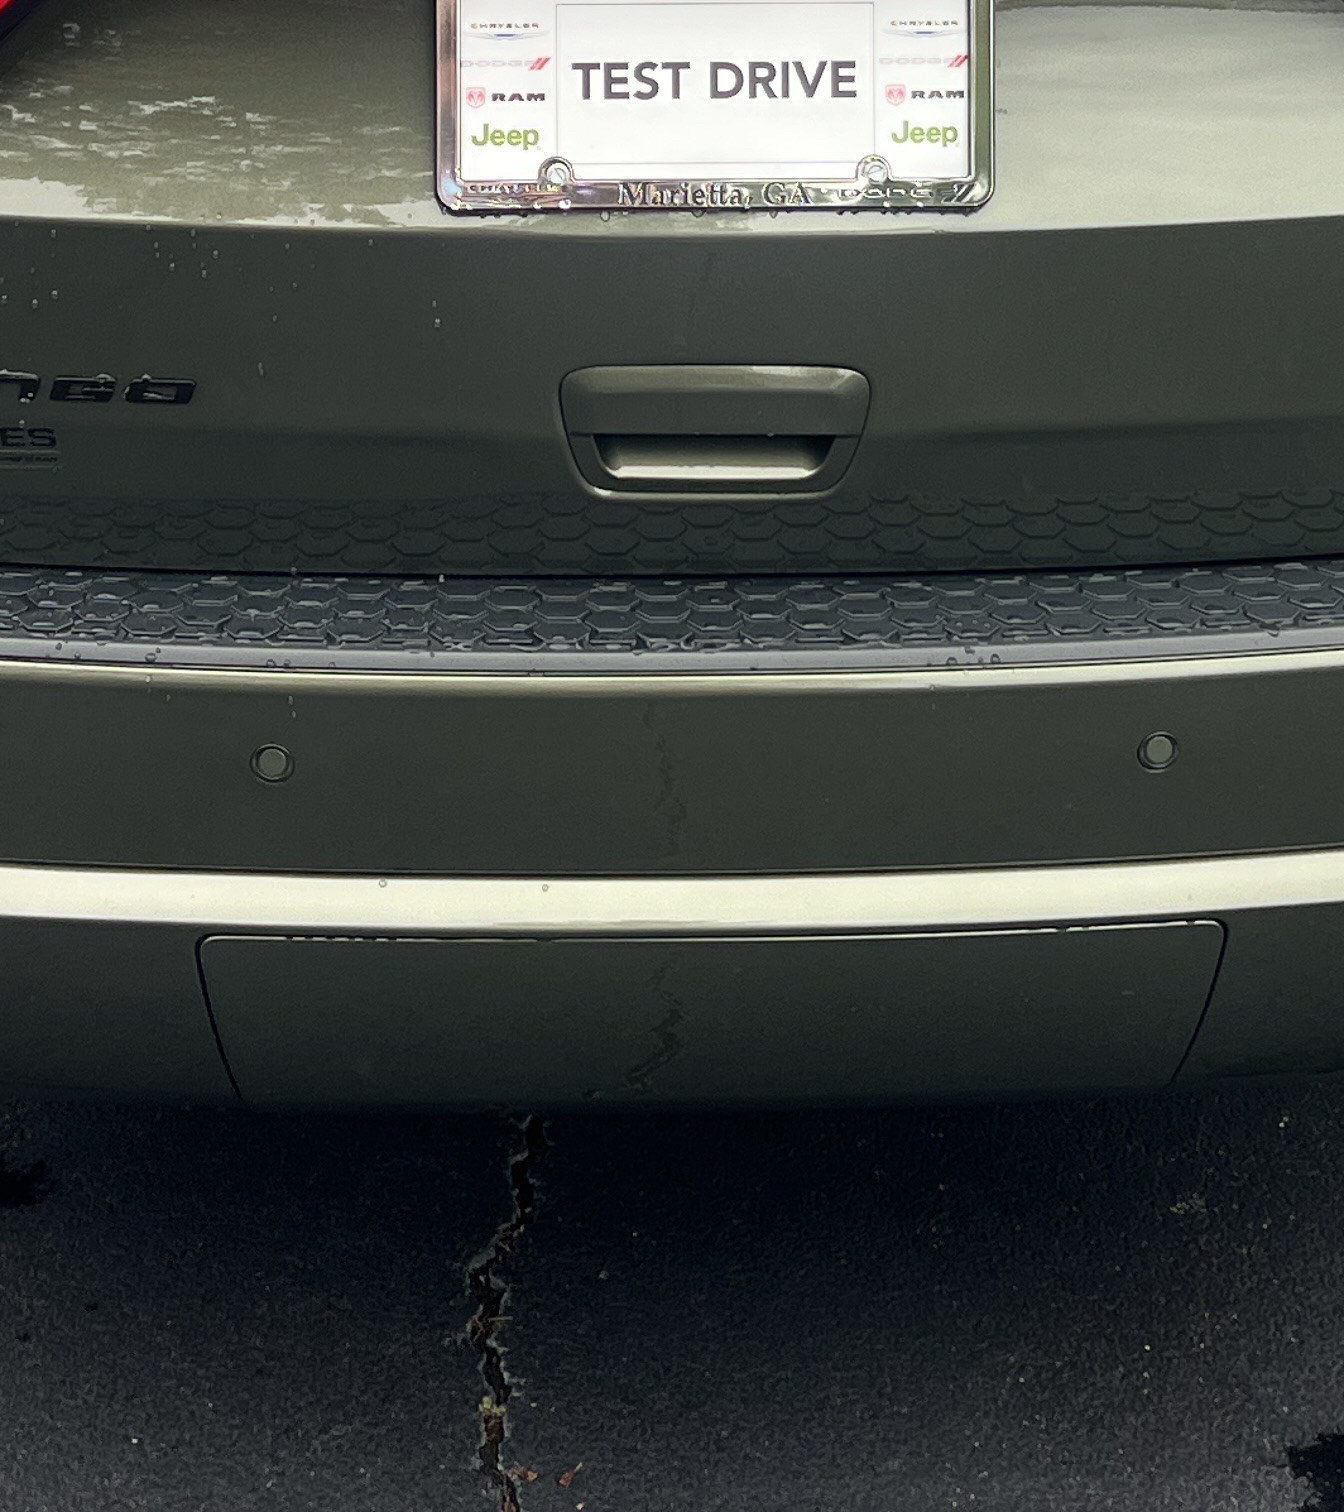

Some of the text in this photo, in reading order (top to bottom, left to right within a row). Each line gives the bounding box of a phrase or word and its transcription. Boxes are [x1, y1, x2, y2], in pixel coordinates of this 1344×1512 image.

[571, 60, 857, 100] TEST DRIVE
[491, 93, 546, 101] RAM
[911, 90, 965, 99] RAM
[471, 123, 539, 150] Jeep
[891, 120, 959, 147] Jeep
[762, 181, 814, 205] GA
